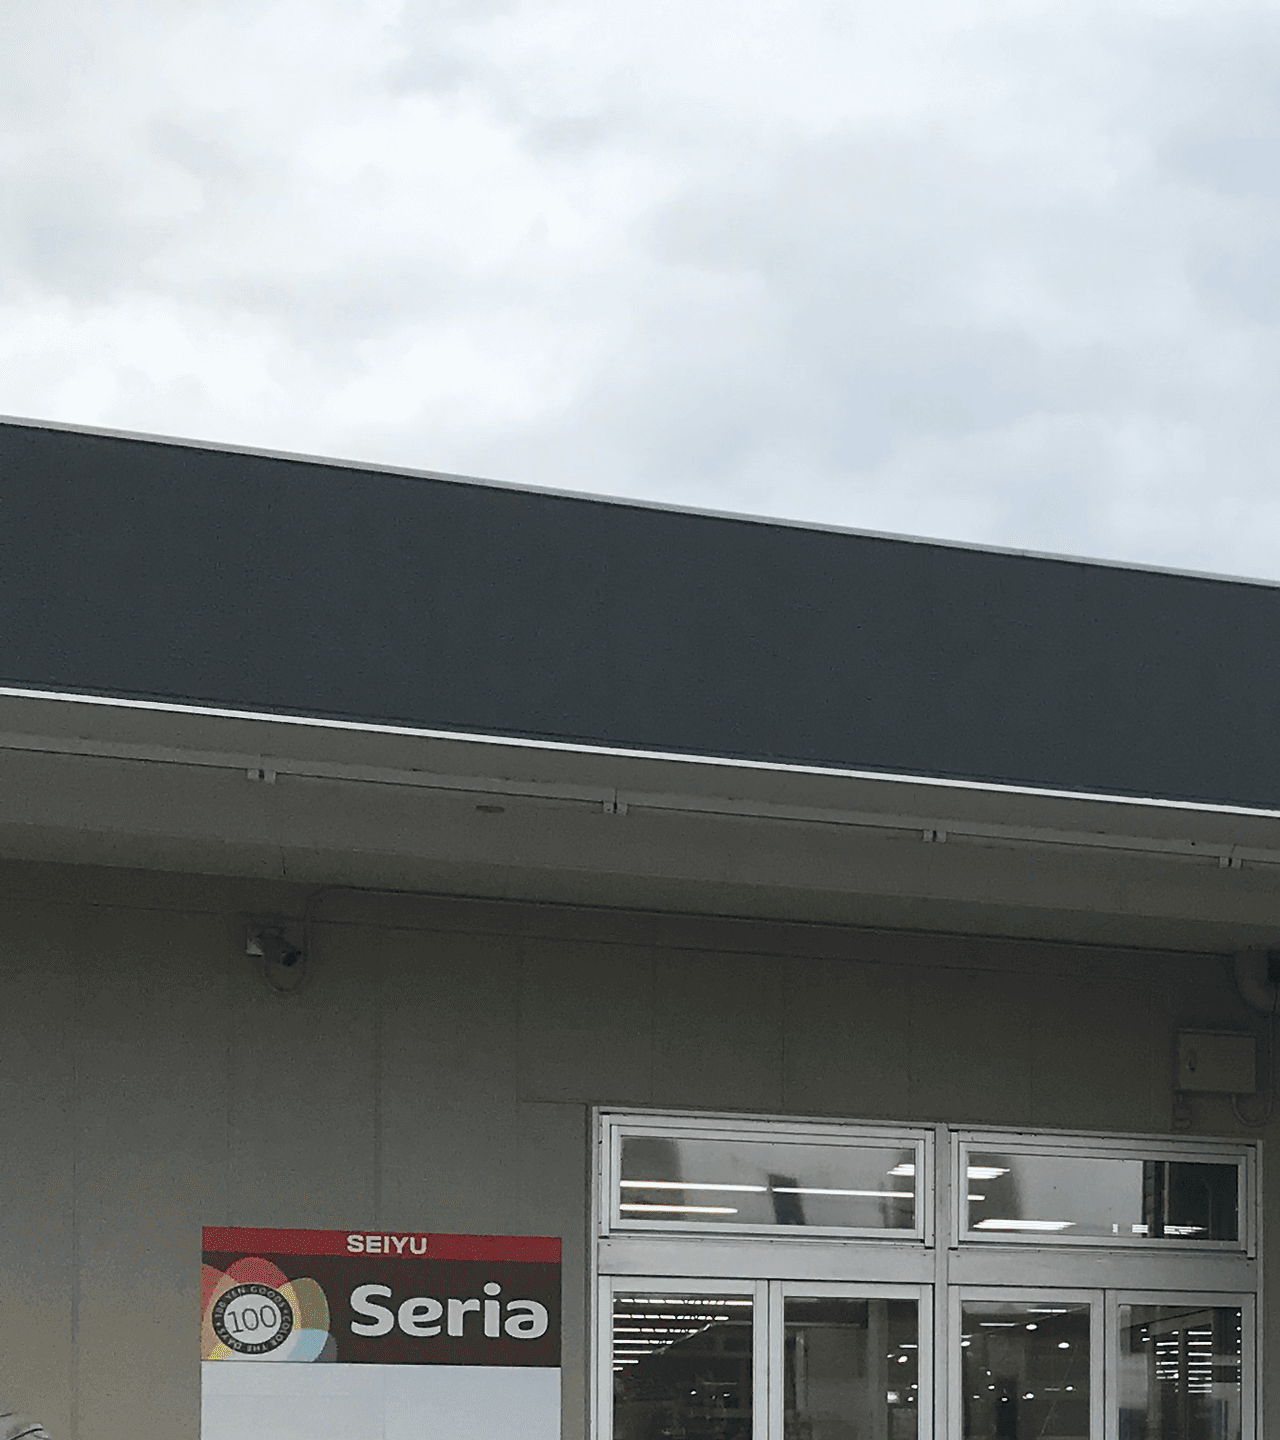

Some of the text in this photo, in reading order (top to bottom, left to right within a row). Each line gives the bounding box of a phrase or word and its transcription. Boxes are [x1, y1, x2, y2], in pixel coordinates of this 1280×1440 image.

[347, 1234, 427, 1255] SEIYU
[225, 1288, 246, 1300] YEN
[250, 1285, 286, 1308] GOODS
[227, 1304, 277, 1333] 100
[350, 1282, 549, 1339] Seria
